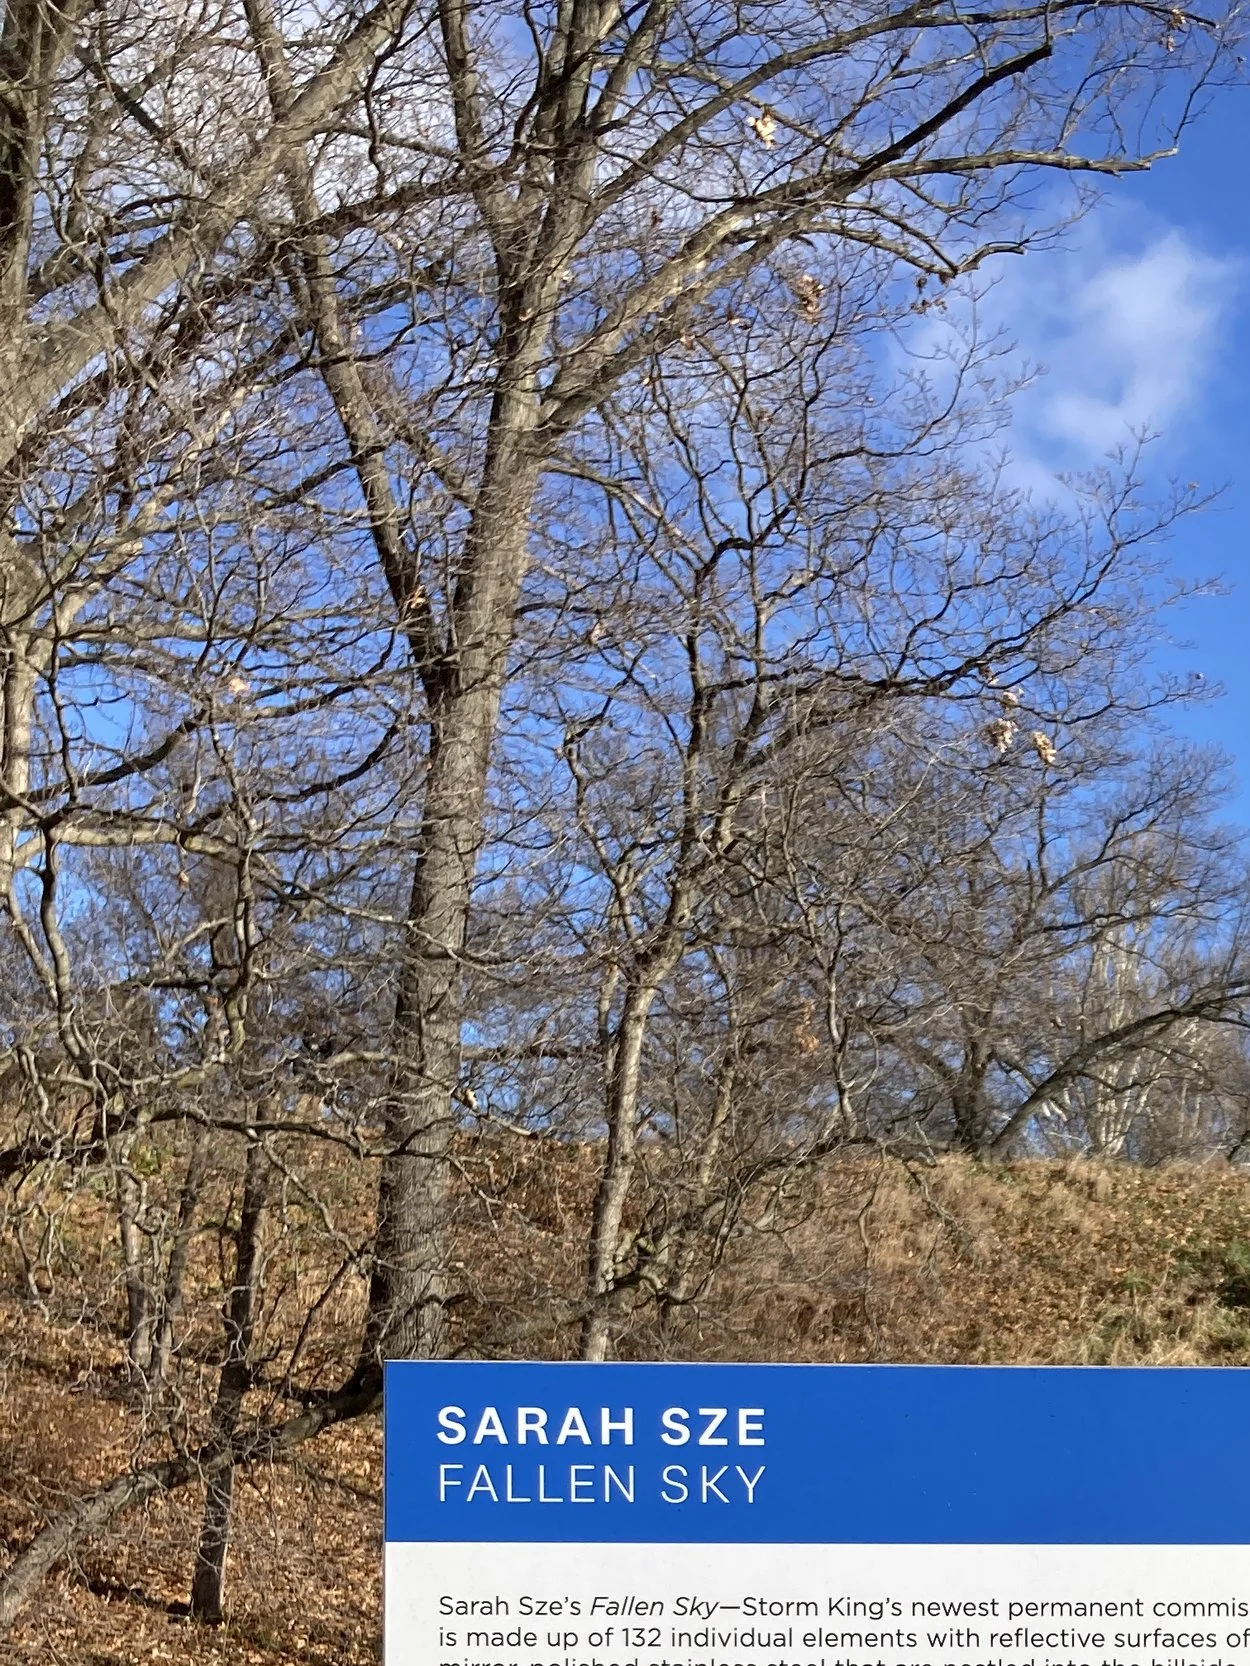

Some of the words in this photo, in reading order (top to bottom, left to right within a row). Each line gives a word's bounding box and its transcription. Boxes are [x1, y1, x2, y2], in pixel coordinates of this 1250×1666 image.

[436, 1405, 634, 1445] SARAH
[660, 1407, 765, 1446] SZE
[439, 1464, 635, 1503] FALLEN
[660, 1464, 766, 1504] SKY
[438, 1595, 510, 1616] Sarah
[518, 1595, 582, 1616] Sze’s
[589, 1595, 665, 1617] Fallen
[672, 1595, 819, 1621] Sky—Storm
[828, 1596, 903, 1621] King’s
[911, 1597, 1000, 1617] newest
[1008, 1597, 1145, 1621] permanent
[439, 1626, 457, 1647] is
[466, 1626, 538, 1648] made
[547, 1631, 579, 1652] up
[587, 1626, 615, 1648] of
[621, 1627, 662, 1648] 132
[671, 1626, 793, 1648] individual
[802, 1626, 918, 1648] elements
[926, 1627, 980, 1648] with
[989, 1627, 1106, 1649] reflective
[1113, 1627, 1217, 1649] surfaces
